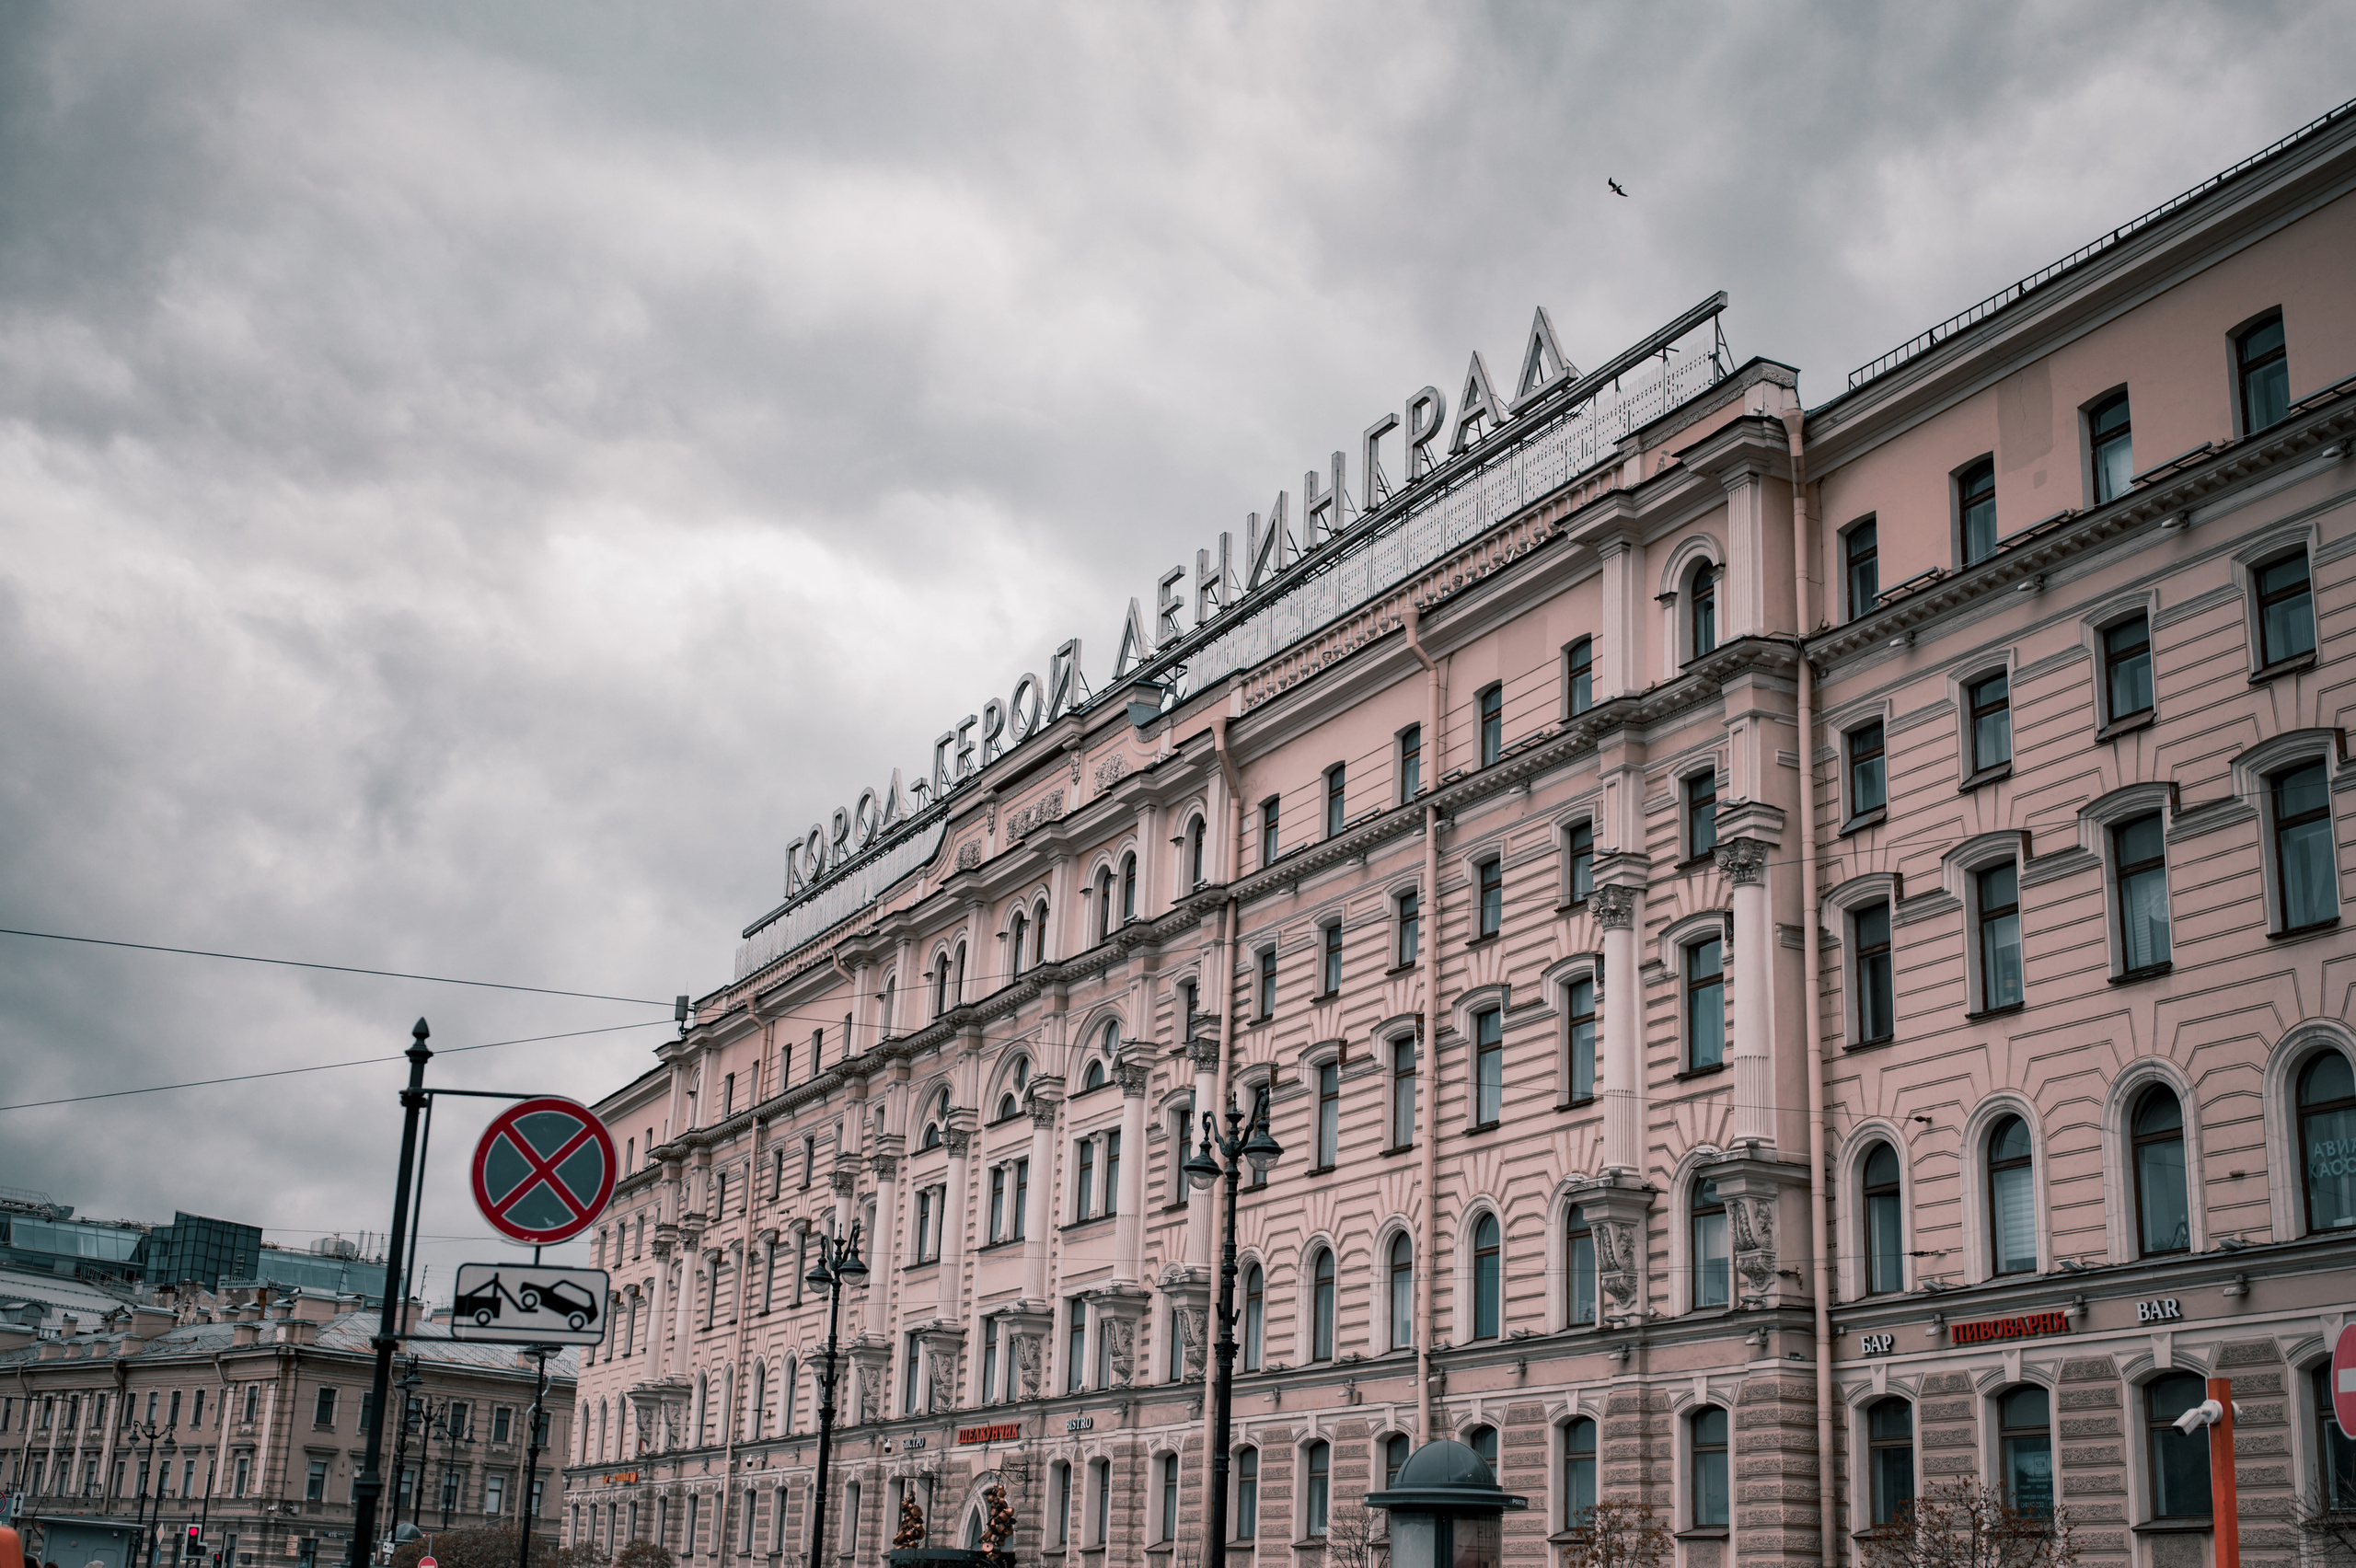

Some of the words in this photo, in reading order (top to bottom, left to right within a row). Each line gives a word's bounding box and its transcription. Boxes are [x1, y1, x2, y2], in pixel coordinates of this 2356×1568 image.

[1112, 306, 1577, 680] ЛЕНИНГРАД
[2135, 1298, 2180, 1321] BAR
[1950, 1310, 2068, 1343] ПИВОВАРНЯ
[1860, 1333, 1892, 1354] БАР
[1066, 1417, 1091, 1430] BISTRO
[902, 1436, 925, 1449] БИСТРО
